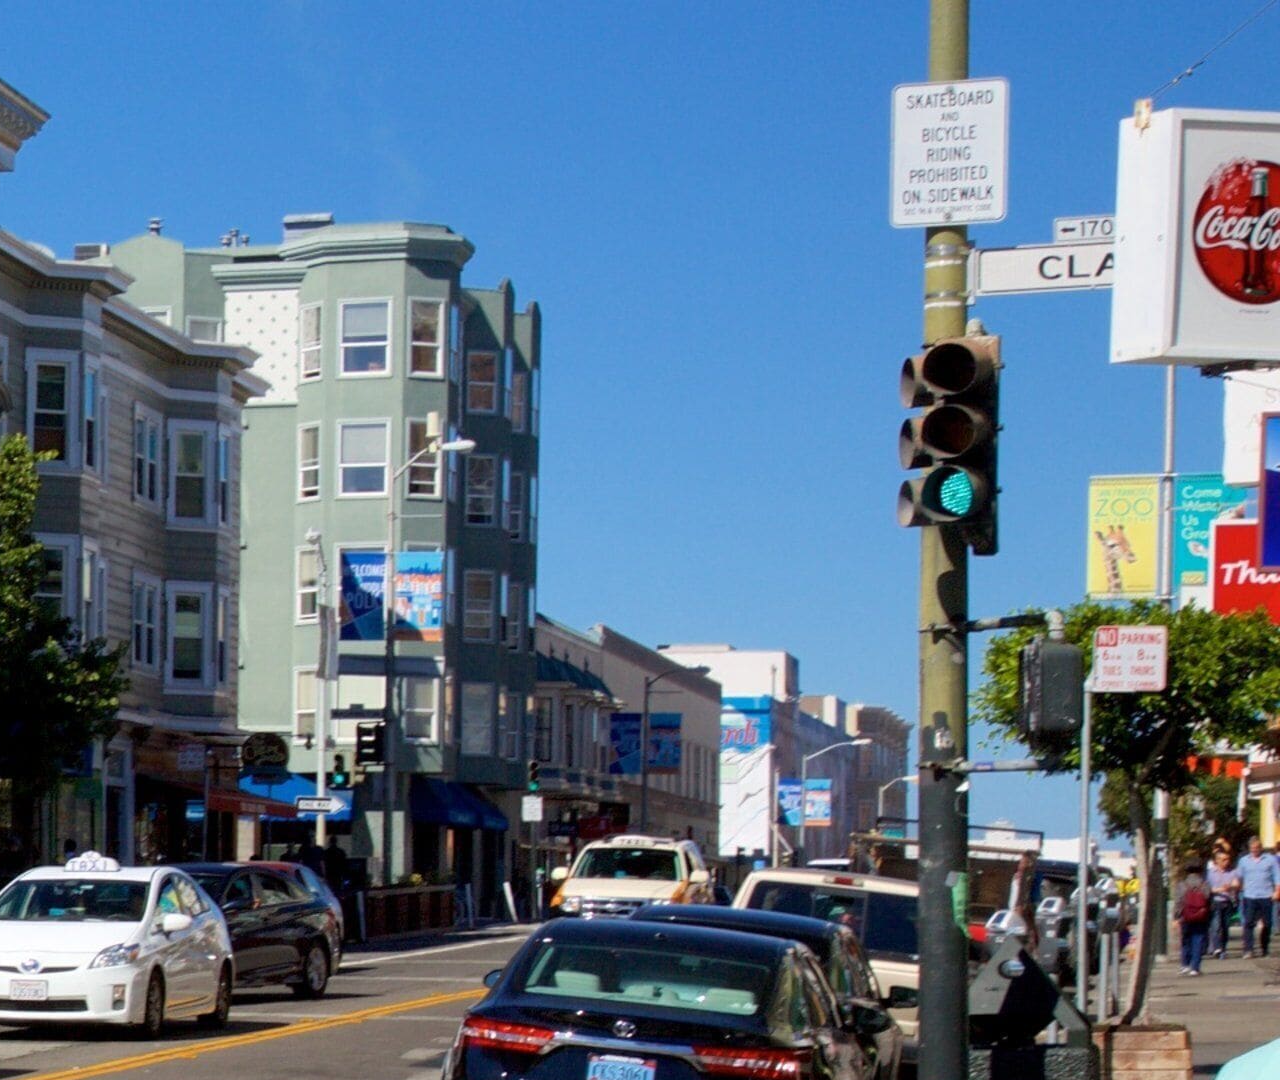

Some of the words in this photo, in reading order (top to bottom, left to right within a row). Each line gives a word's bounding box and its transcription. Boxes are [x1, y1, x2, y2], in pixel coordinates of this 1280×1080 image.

[906, 89, 994, 110] SKATEBOARD
[940, 111, 960, 122] AND
[921, 124, 978, 143] BICYCLE
[926, 146, 971, 162] RIDING
[909, 165, 989, 183] PROHIBITED
[902, 190, 921, 205] ON
[928, 185, 994, 203] SIDEWALK
[1039, 252, 1115, 280] CLA
[1181, 485, 1223, 500] Come
[1095, 497, 1155, 518] ZOO
[1181, 514, 1200, 526] Us
[1181, 527, 1209, 541] Gro
[345, 563, 386, 577] ELCOME
[1098, 629, 1117, 646] NO
[1120, 632, 1163, 646] PARKING
[68, 859, 109, 872] TAXI
